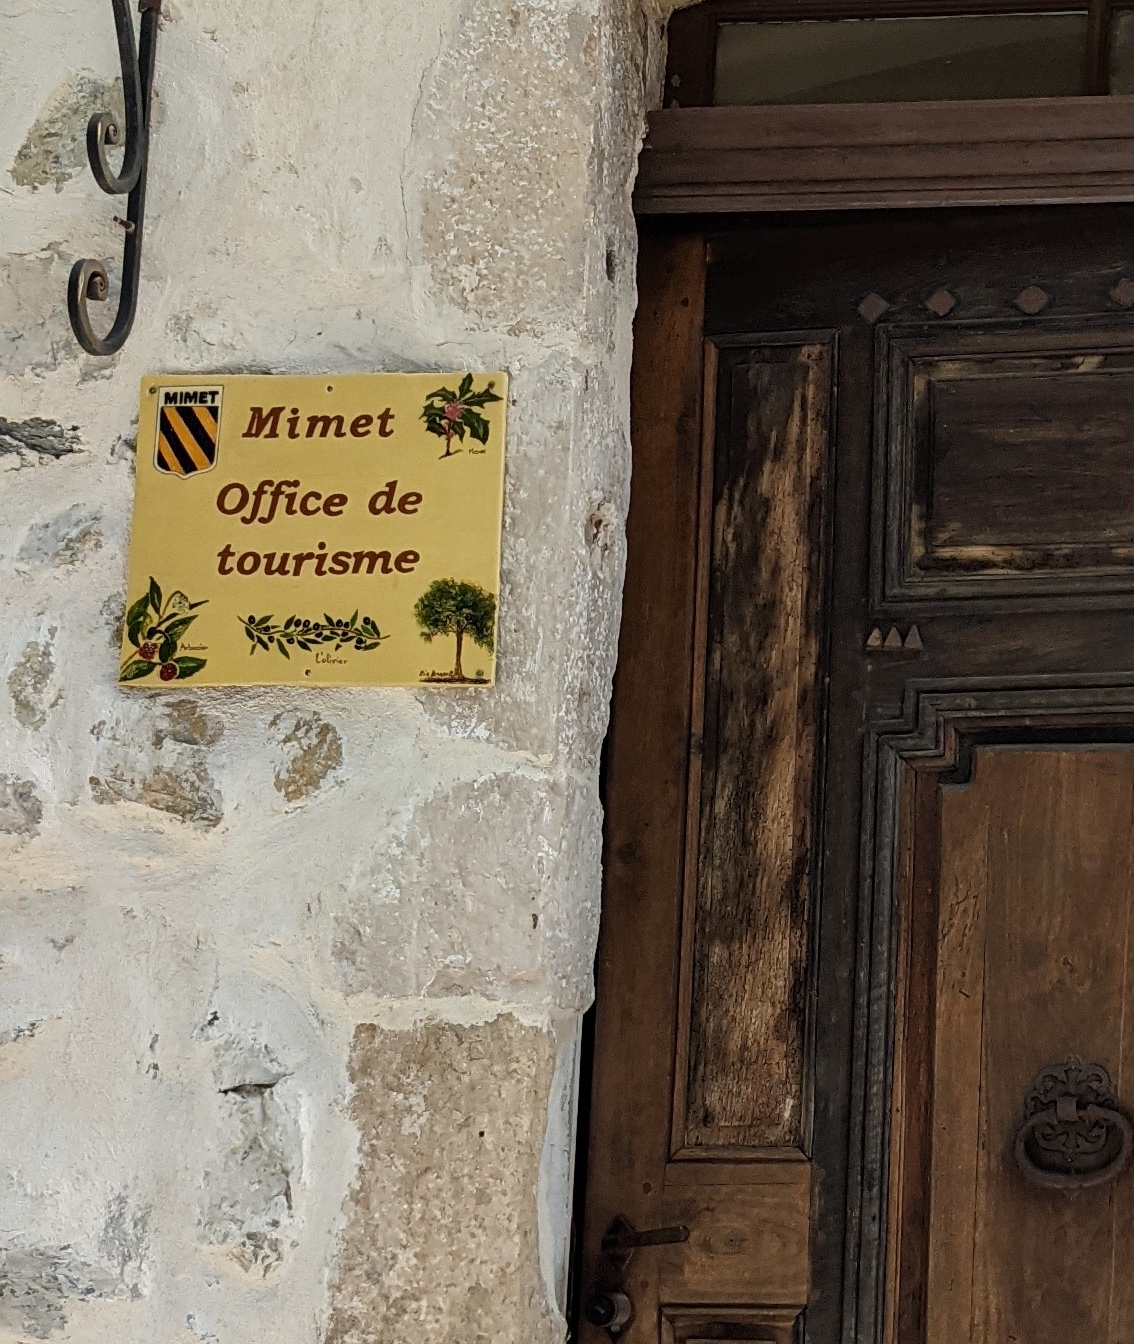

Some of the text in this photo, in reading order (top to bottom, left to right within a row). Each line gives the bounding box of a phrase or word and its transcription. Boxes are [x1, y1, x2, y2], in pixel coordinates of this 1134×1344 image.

[164, 390, 219, 405] MIMET
[242, 406, 395, 439] Mimet
[216, 479, 423, 524] Office de
[216, 542, 420, 576] tourisme
